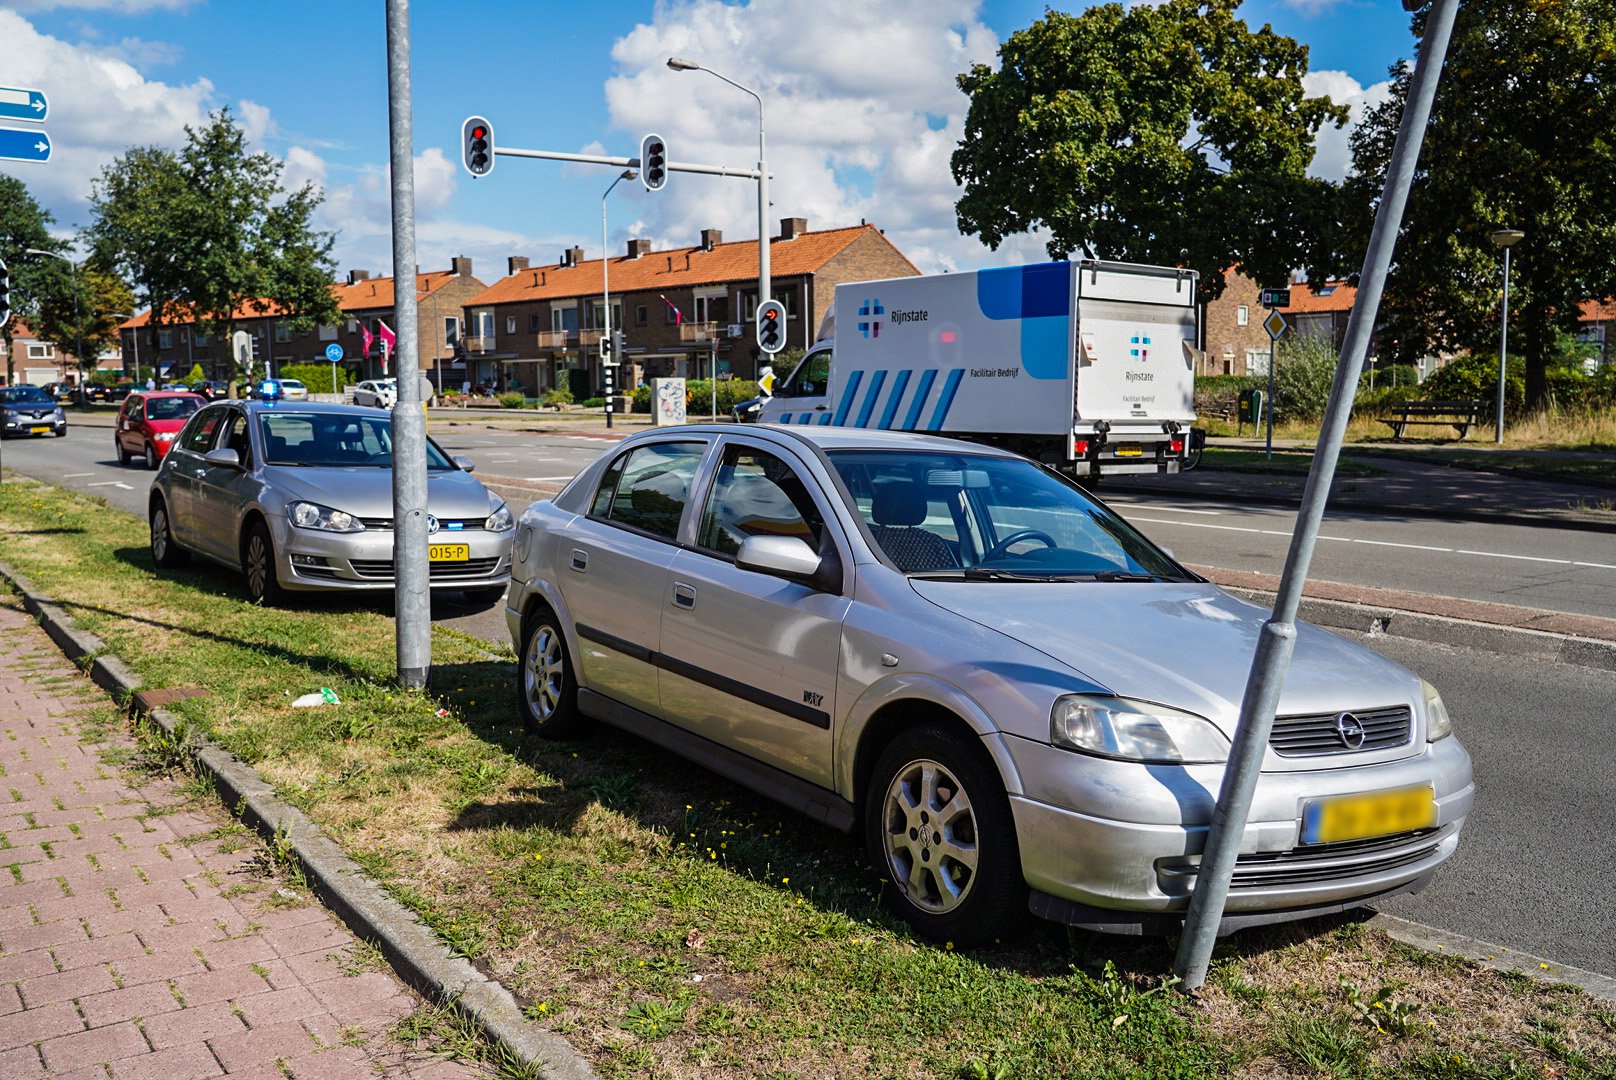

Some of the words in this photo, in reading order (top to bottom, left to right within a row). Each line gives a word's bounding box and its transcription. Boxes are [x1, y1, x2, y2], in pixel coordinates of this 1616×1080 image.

[891, 309, 928, 325] Rijnstate
[970, 369, 996, 378] Facilitair
[997, 367, 1019, 379] Bedrijf
[1126, 372, 1154, 382] Rijnstate
[430, 547, 464, 558] 015-P
